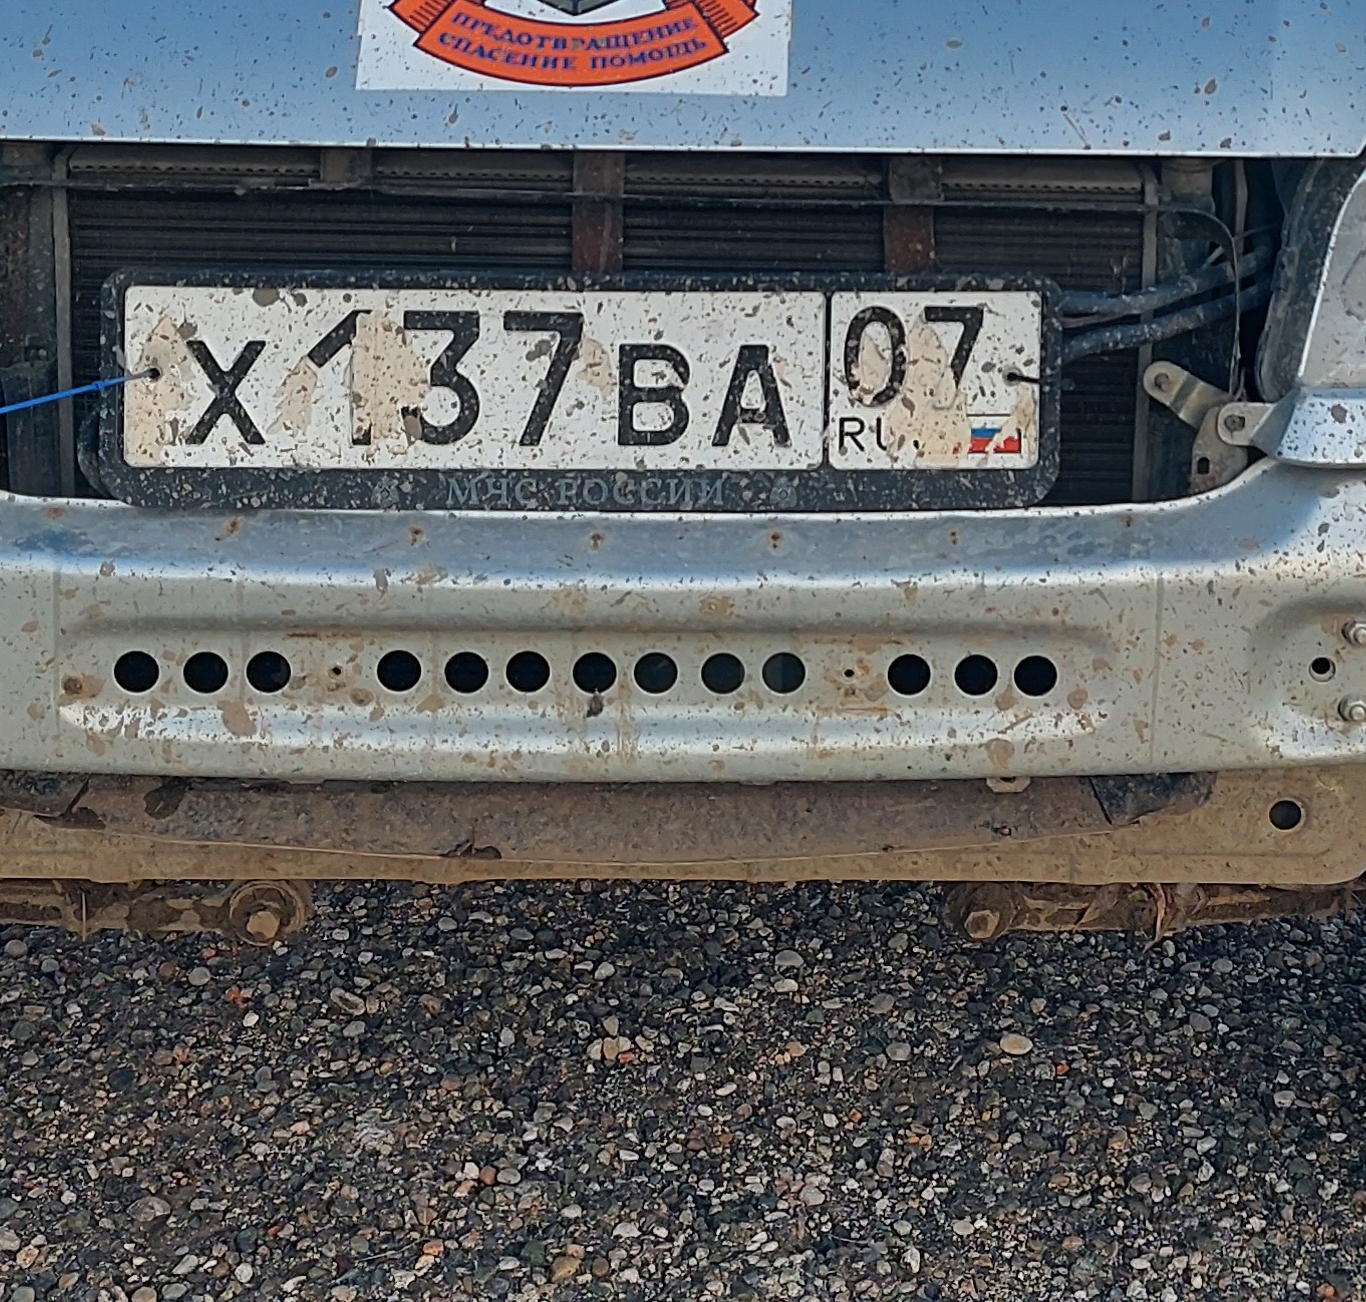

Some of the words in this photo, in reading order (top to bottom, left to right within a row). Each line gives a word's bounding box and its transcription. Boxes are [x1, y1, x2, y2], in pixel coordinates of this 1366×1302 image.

[437, 31, 577, 71] СПАСЕНИЕ
[588, 37, 708, 70] ПОМОЩЬ
[451, 11, 699, 51] ПРЕДОТВРАЩЕНИЕ
[843, 305, 984, 409] 07
[445, 477, 538, 506] МЧС
[556, 477, 725, 506] РОССИИ
